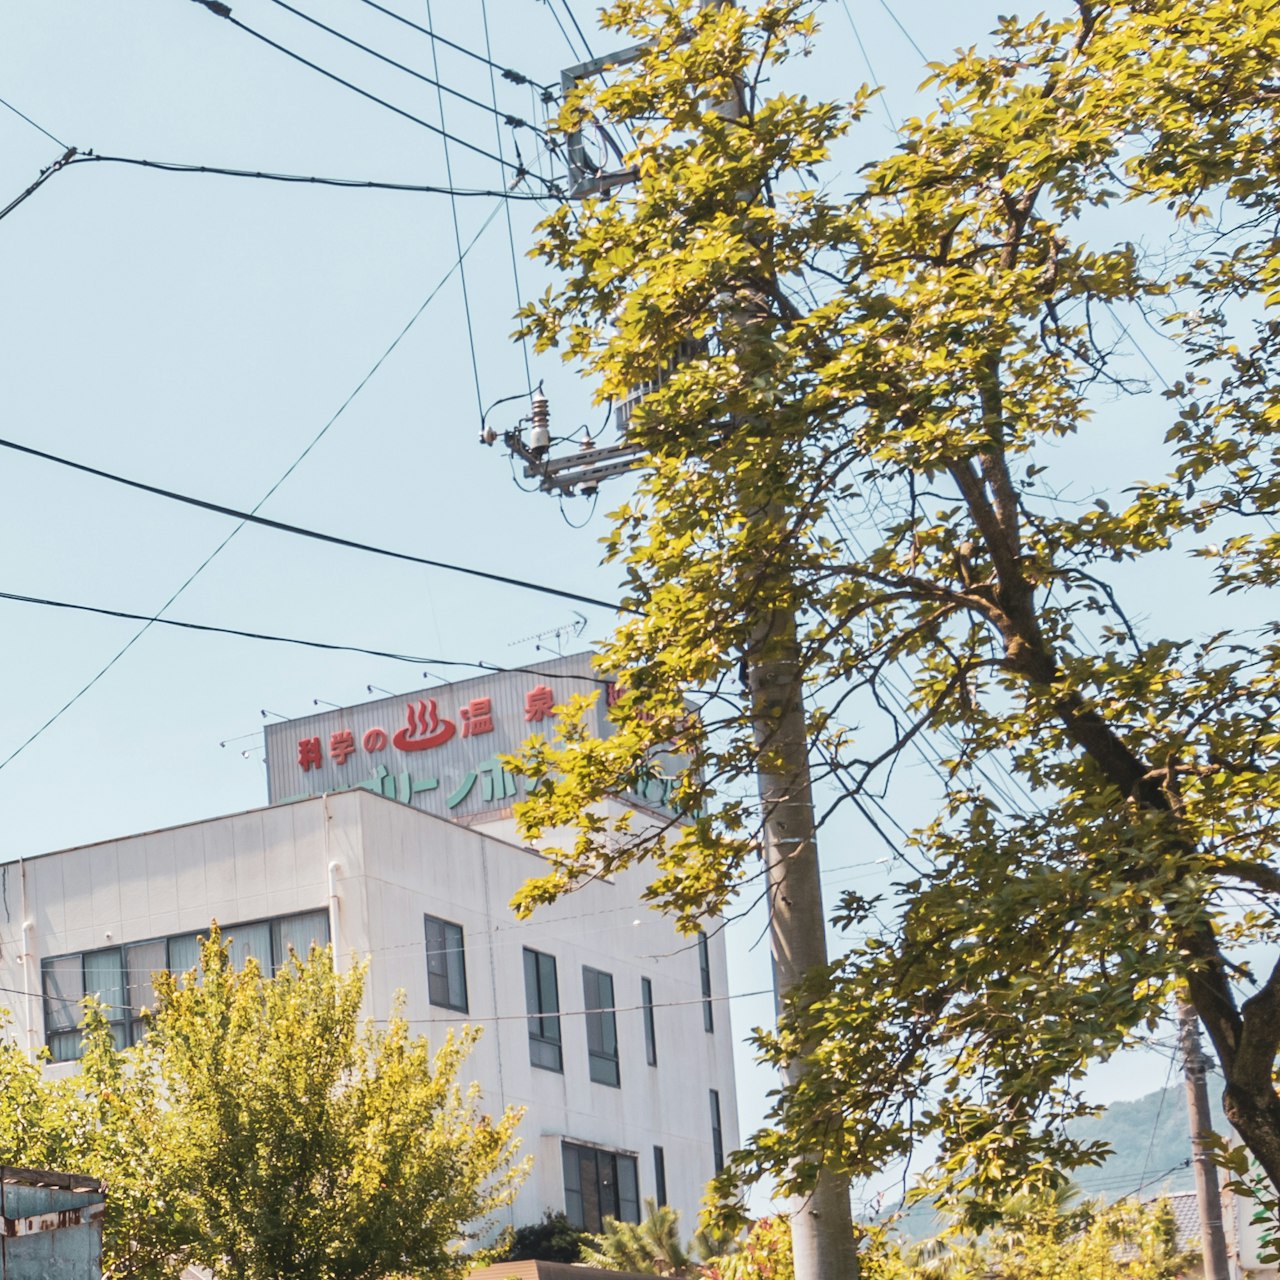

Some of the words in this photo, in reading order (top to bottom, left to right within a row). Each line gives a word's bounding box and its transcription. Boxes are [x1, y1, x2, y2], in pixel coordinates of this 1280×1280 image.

[297, 727, 388, 773] 科学の
[459, 684, 556, 739] 温泉
